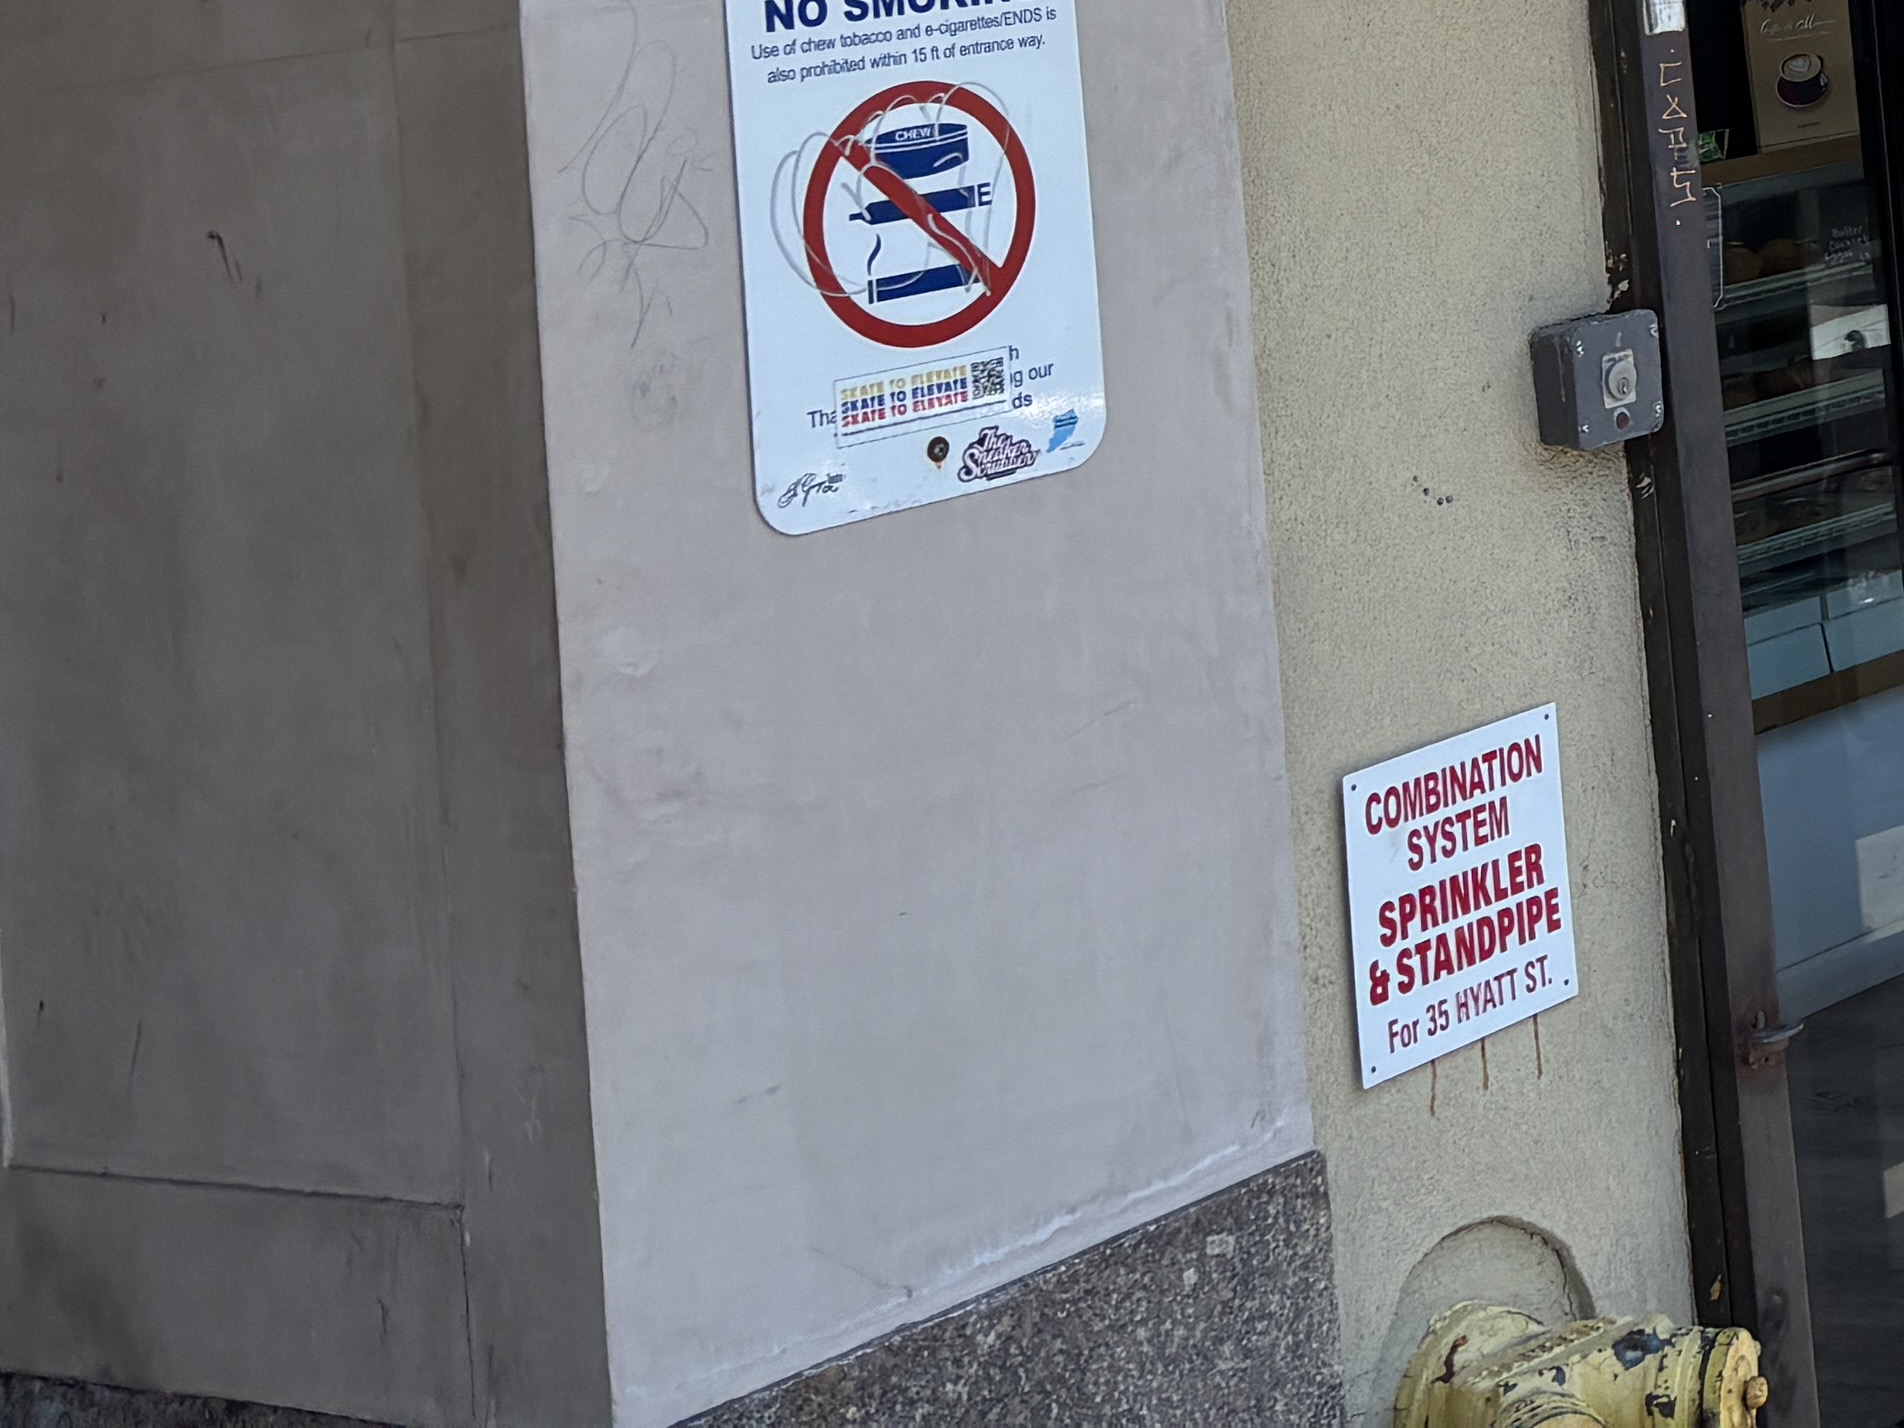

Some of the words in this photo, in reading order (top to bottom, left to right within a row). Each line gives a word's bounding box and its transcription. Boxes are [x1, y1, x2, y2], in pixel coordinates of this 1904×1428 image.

[751, 43, 780, 60] Use
[783, 41, 797, 56] of
[800, 35, 836, 53] chew
[840, 30, 893, 47] tobacco
[896, 24, 921, 41] and
[925, 8, 1043, 37] e-cigarettes/ENDS
[1046, 6, 1057, 20] is
[767, 67, 796, 84] also
[800, 57, 866, 82] prohibited
[869, 52, 908, 69] within
[911, 48, 928, 64] 15
[931, 44, 940, 61] ft
[943, 43, 956, 59] of
[959, 37, 1015, 57] entrance
[1018, 34, 1046, 52] way.
[895, 128, 932, 142] CHEW
[977, 182, 993, 207] E
[841, 379, 885, 401] SKATE
[889, 377, 907, 394] TO
[911, 364, 967, 388] ELEVATE
[841, 394, 886, 414] SKATE
[890, 390, 907, 406] TO
[912, 376, 968, 400] ELEVATE
[1027, 361, 1054, 382] our
[841, 407, 887, 428] SKATE
[891, 401, 908, 418] TO
[912, 391, 969, 414] ELEVATE
[1365, 734, 1542, 835] COMBINATION
[1407, 796, 1510, 871] SYSTEM
[1379, 843, 1544, 947] SPRINKLER
[1369, 959, 1390, 1006] &
[1396, 887, 1562, 994] STANDPIPE
[1388, 1018, 1419, 1053] For
[1426, 998, 1450, 1037] 35
[1457, 968, 1518, 1024] HYATT
[1525, 955, 1553, 994] ST.
